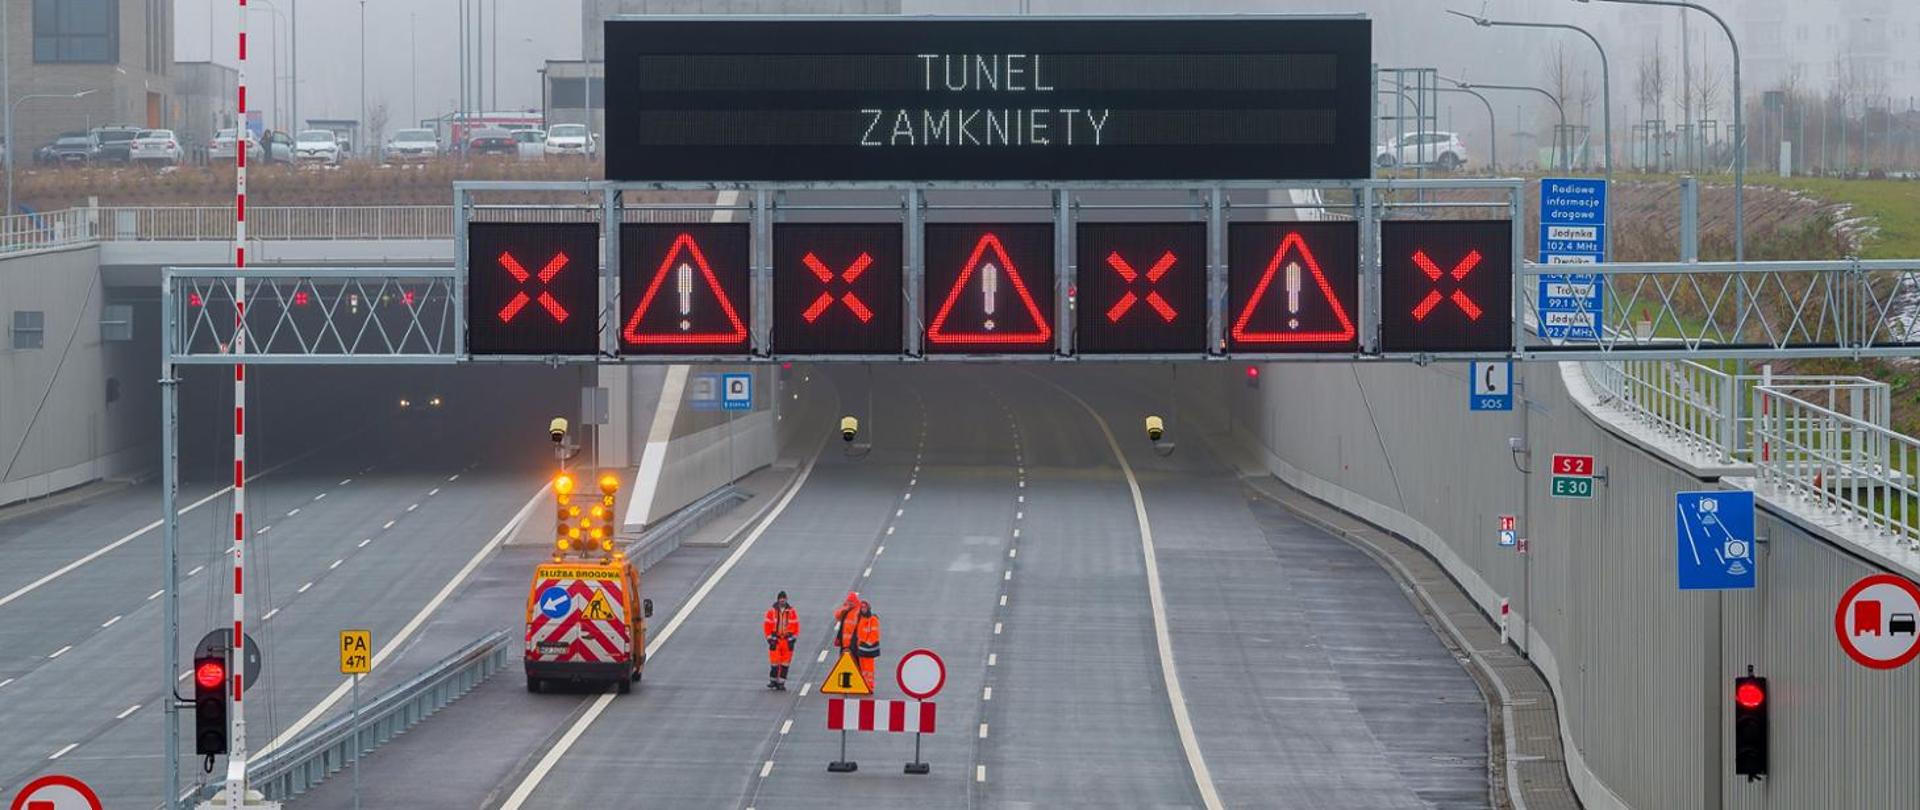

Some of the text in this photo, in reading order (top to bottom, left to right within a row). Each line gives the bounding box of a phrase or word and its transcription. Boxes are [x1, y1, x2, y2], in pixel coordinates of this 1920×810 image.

[917, 54, 1054, 91] TUNEL
[861, 109, 1109, 146] ZAMKNIĘTY
[1552, 184, 1595, 194] Radiowe
[1546, 196, 1600, 208] informacje
[1551, 210, 1595, 221] drogowe
[1552, 228, 1593, 239] Jedynka
[1576, 241, 1598, 251] MHz
[1557, 286, 1587, 296] Tróka
[1481, 399, 1502, 409] SOS
[1562, 459, 1585, 473] S 2
[1556, 480, 1588, 495] E 30
[344, 635, 367, 652] PA
[346, 655, 366, 668] 471
